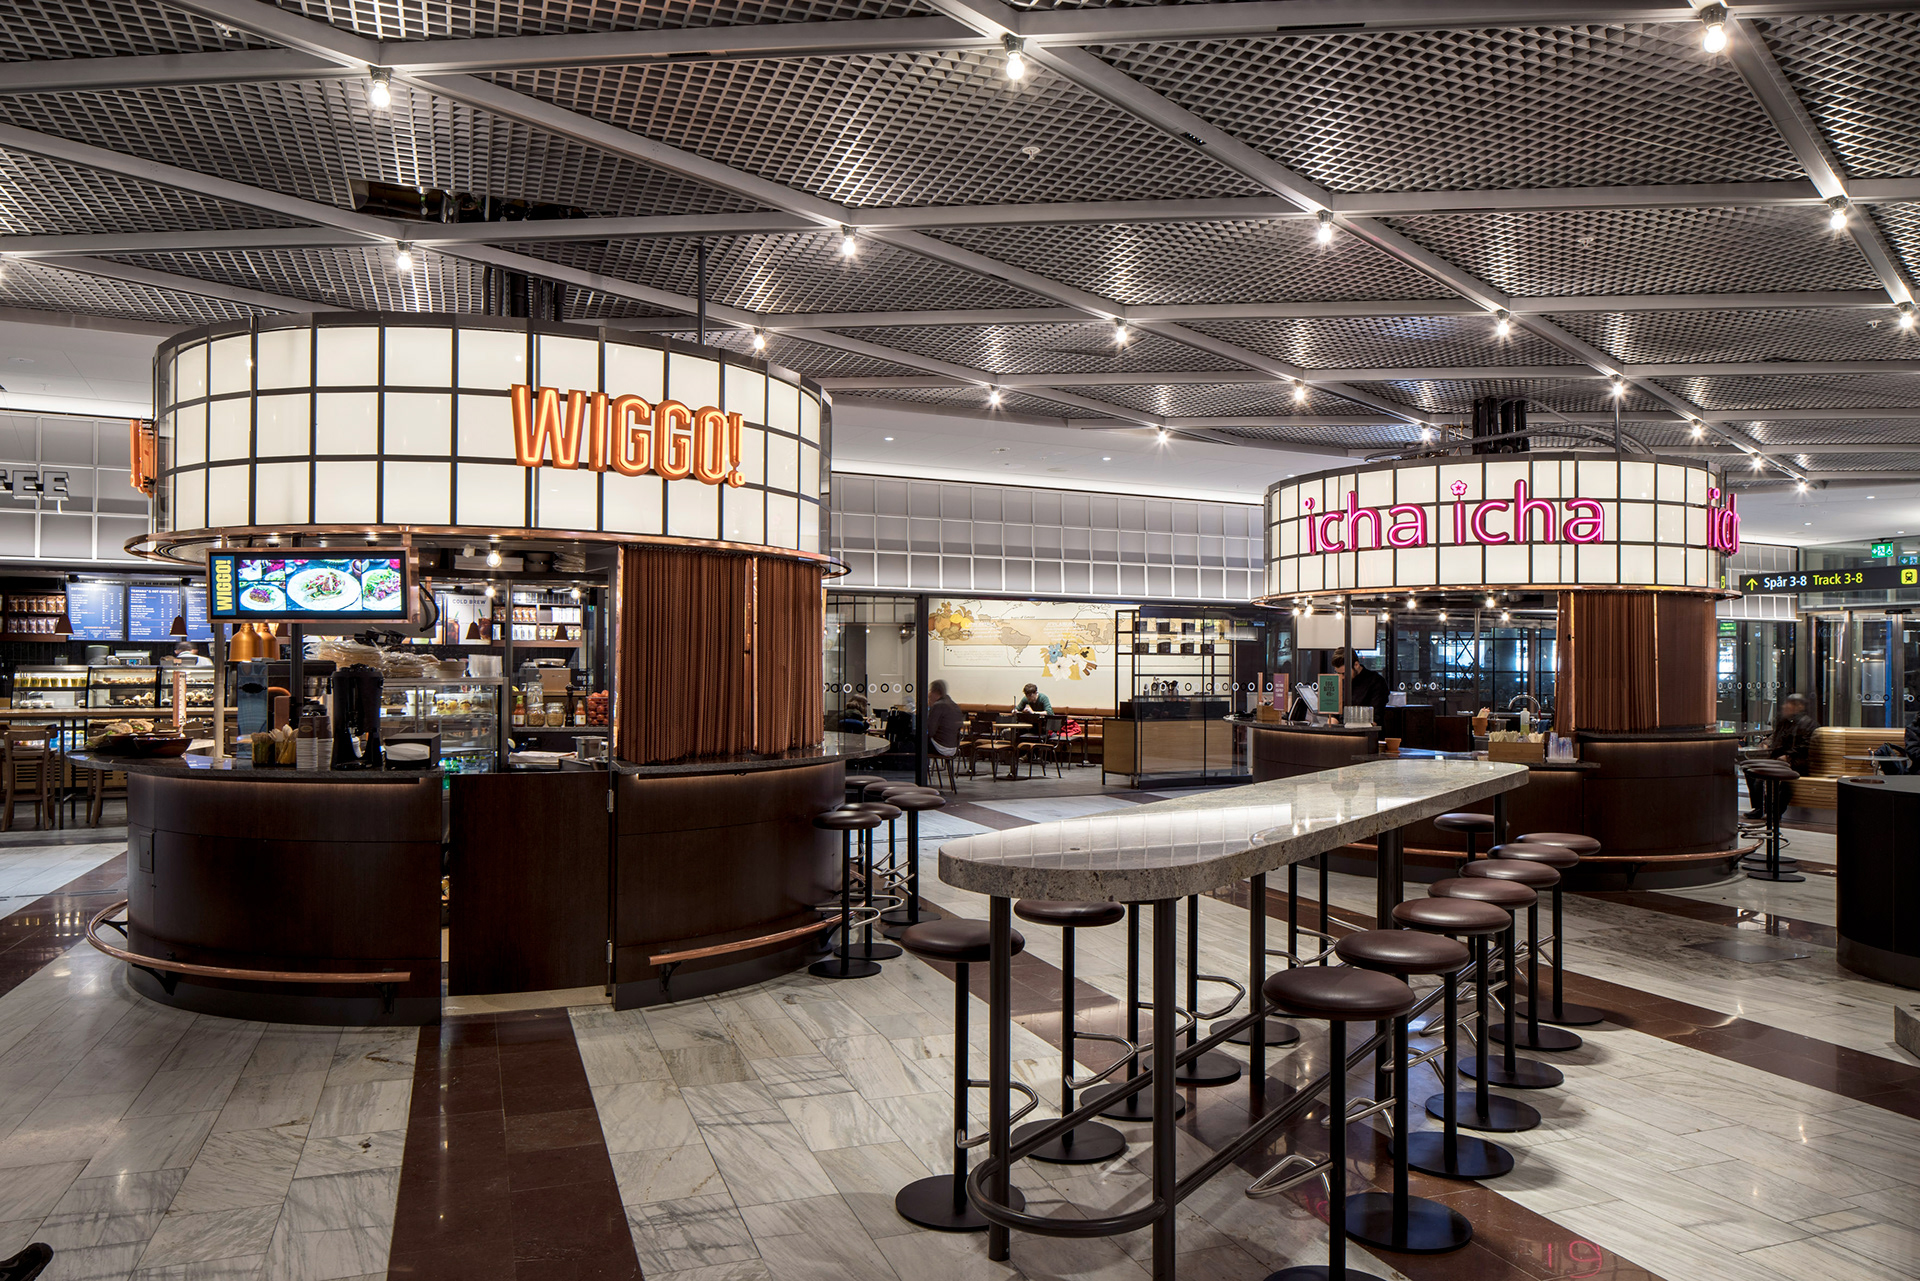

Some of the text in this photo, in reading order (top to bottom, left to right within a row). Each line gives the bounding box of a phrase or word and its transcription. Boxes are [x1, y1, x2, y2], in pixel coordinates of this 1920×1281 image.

[511, 384, 746, 488] WIGGO!
[1303, 479, 1605, 555] icha icha
[215, 559, 233, 611] WIGGO!
[1763, 572, 1863, 591] Spår 3-8 Track 3-8
